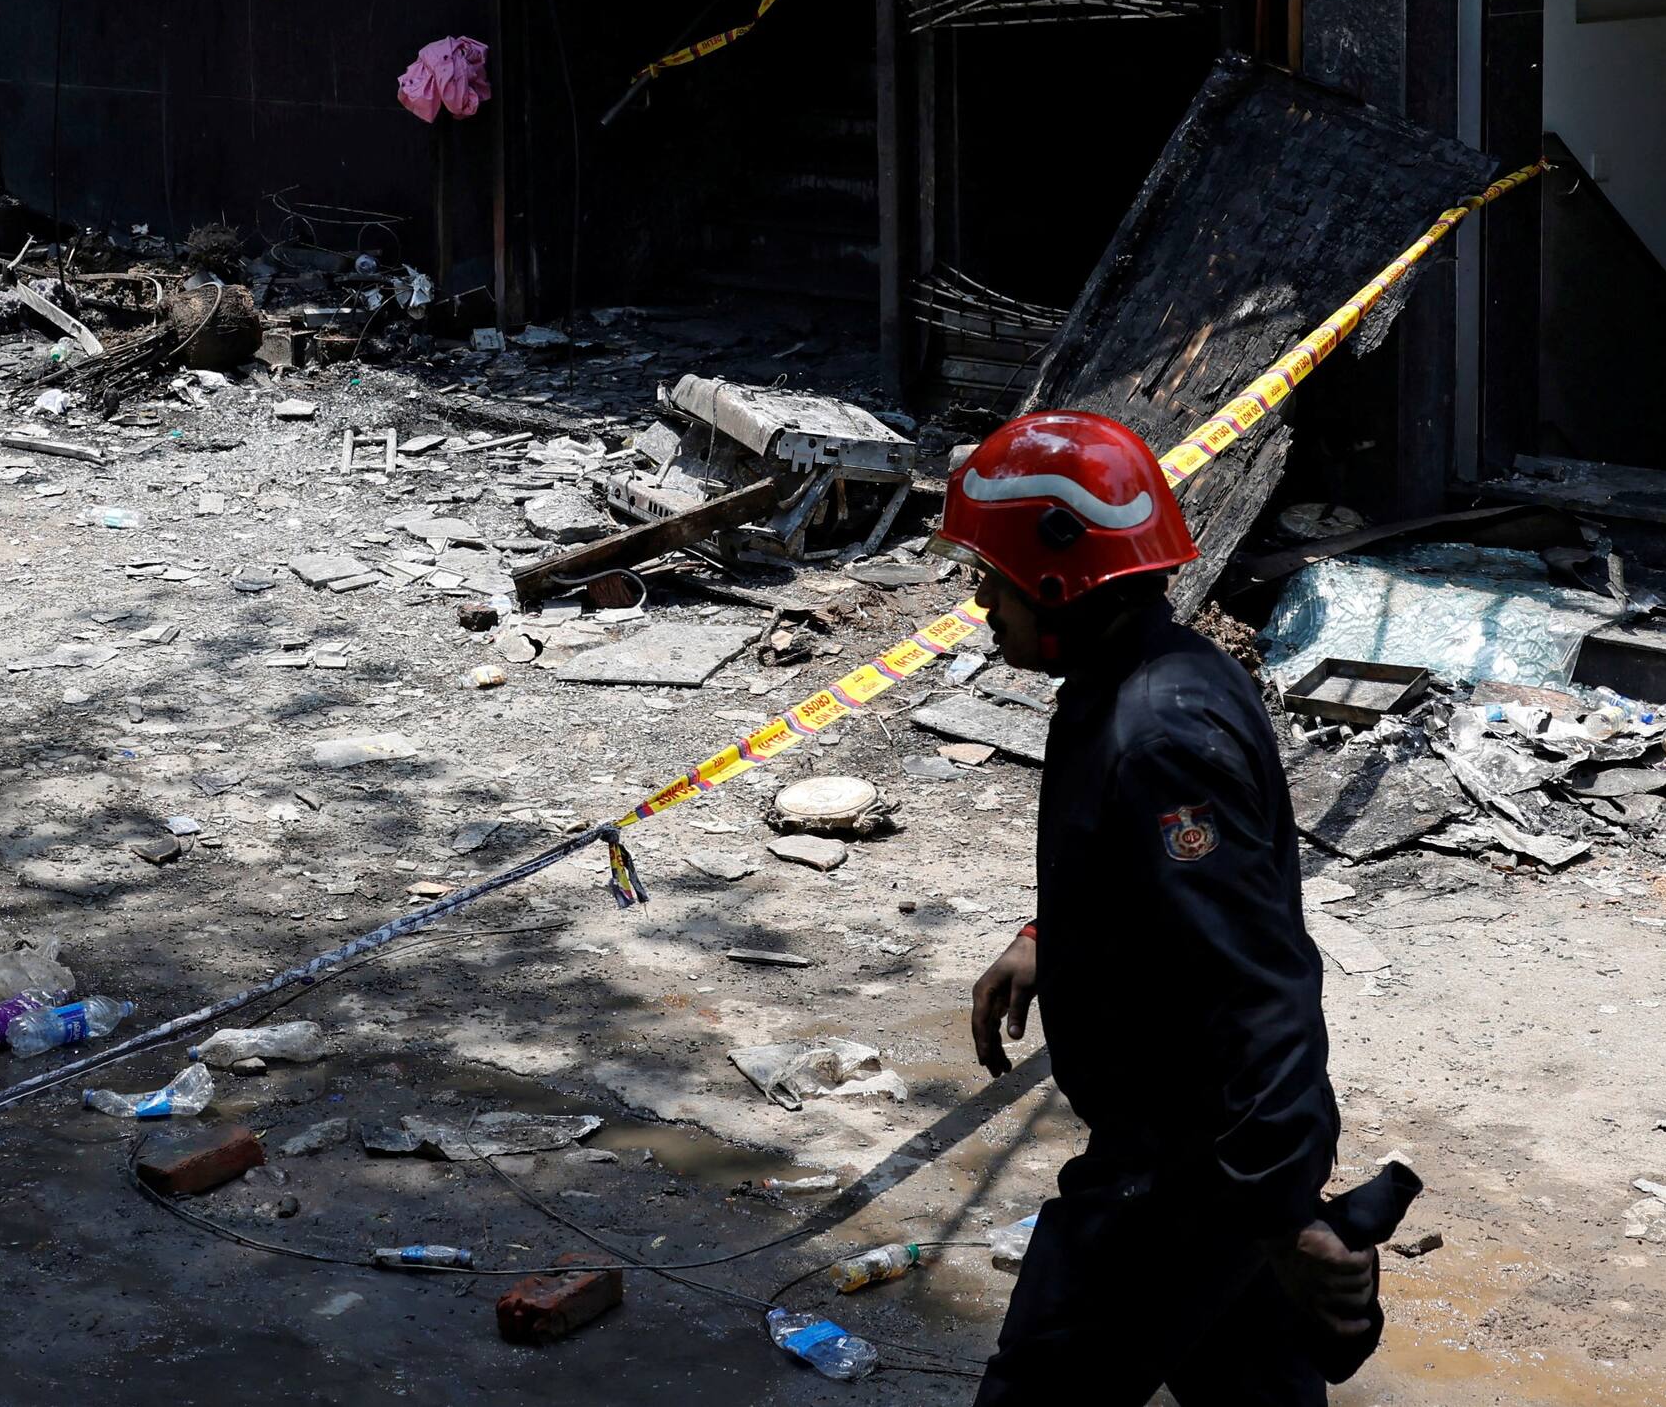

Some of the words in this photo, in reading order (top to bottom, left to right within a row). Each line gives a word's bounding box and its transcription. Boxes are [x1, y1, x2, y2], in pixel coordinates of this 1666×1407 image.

[1291, 355, 1312, 376] DELHI
[1239, 410, 1253, 425] NOT
[1247, 402, 1261, 418] DO
[1207, 424, 1230, 444] DELHI
[928, 617, 956, 637] CROSS
[940, 630, 958, 644] NOT
[956, 625, 971, 636] DO
[892, 644, 924, 668] DELHI
[800, 693, 830, 717] CROSS
[756, 729, 791, 750] DELHI
